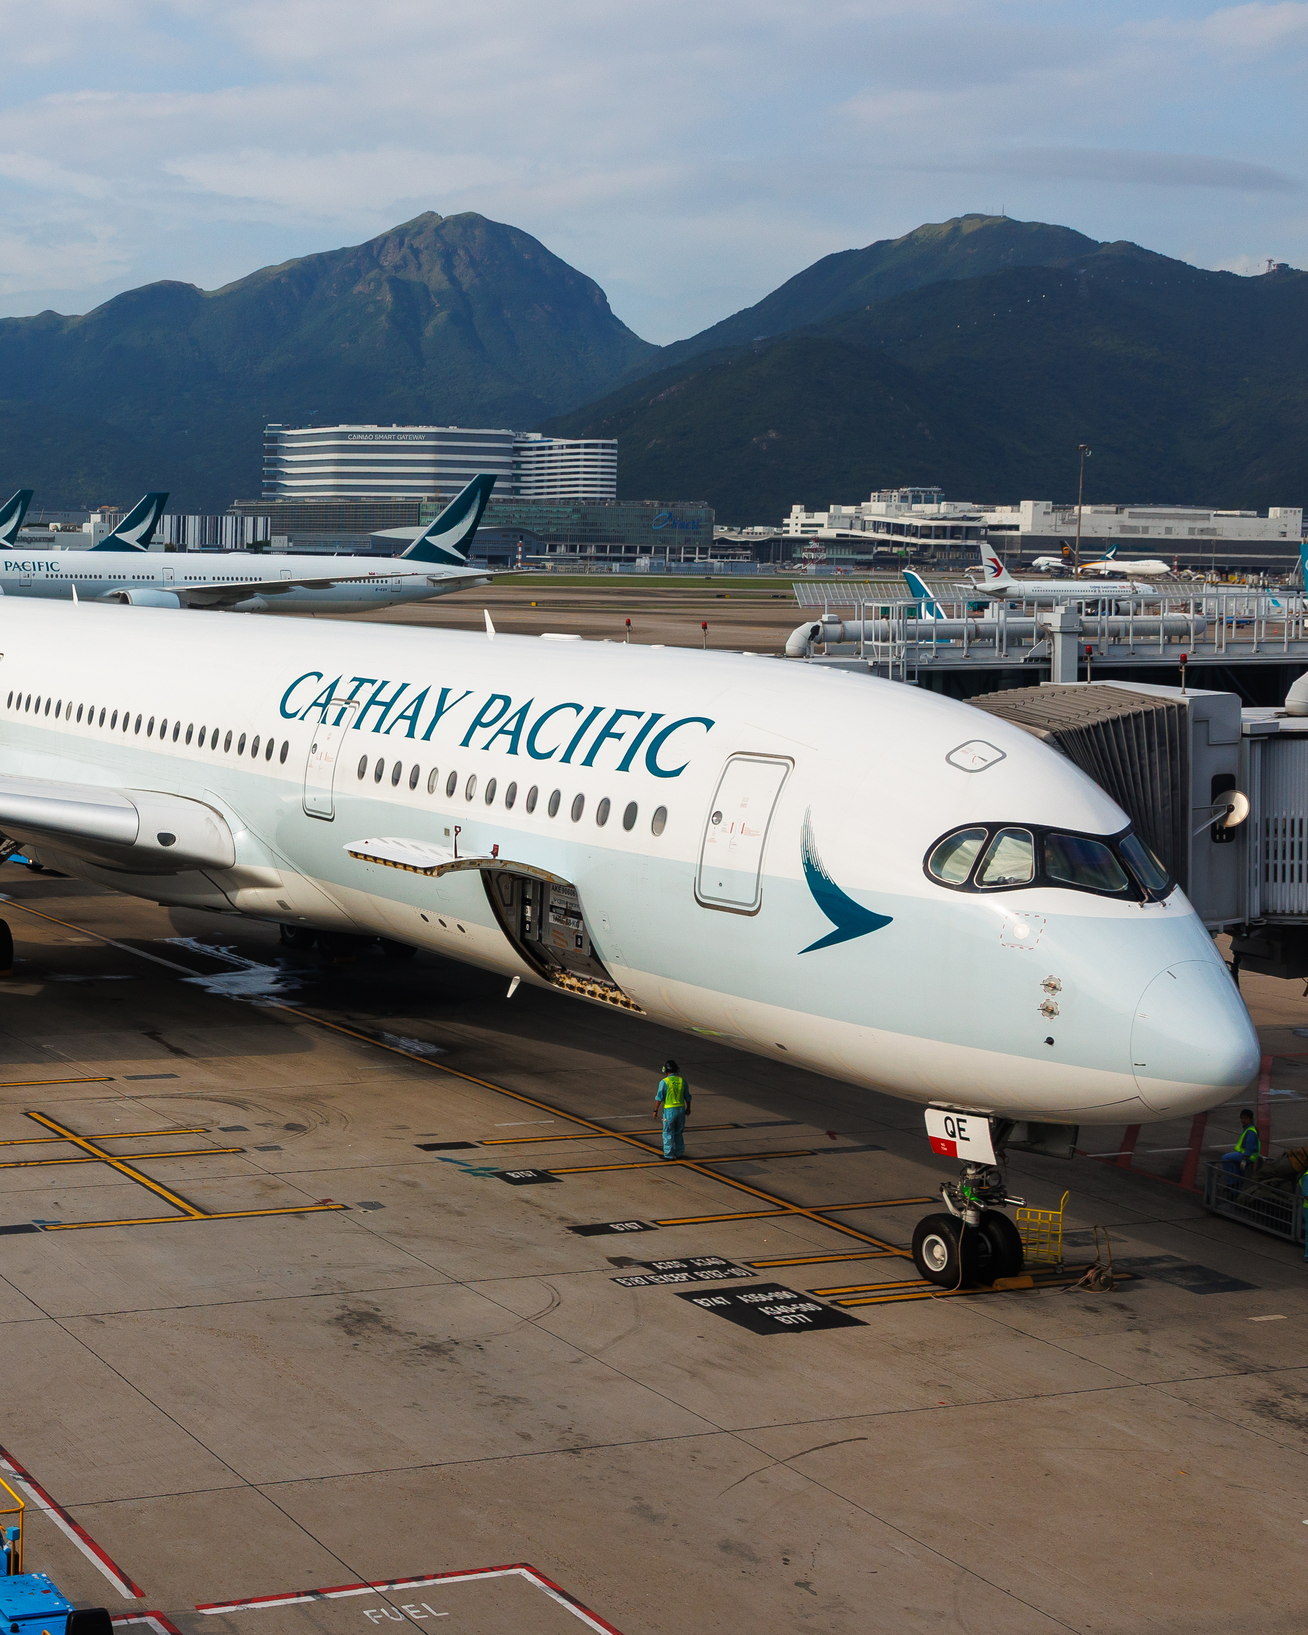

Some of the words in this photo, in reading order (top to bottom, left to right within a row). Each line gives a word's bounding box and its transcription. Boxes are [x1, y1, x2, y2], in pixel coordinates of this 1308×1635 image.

[4, 561, 60, 572] PACIFIC
[280, 671, 475, 742] CATHAY
[459, 693, 716, 779] PACIFIC
[944, 1116, 970, 1141] QE
[506, 1170, 538, 1178] B757
[609, 1222, 644, 1231] B767
[690, 1258, 727, 1268] A340
[692, 1296, 732, 1307] B747
[774, 1315, 814, 1325] B777
[363, 1602, 450, 1625] FUEL
